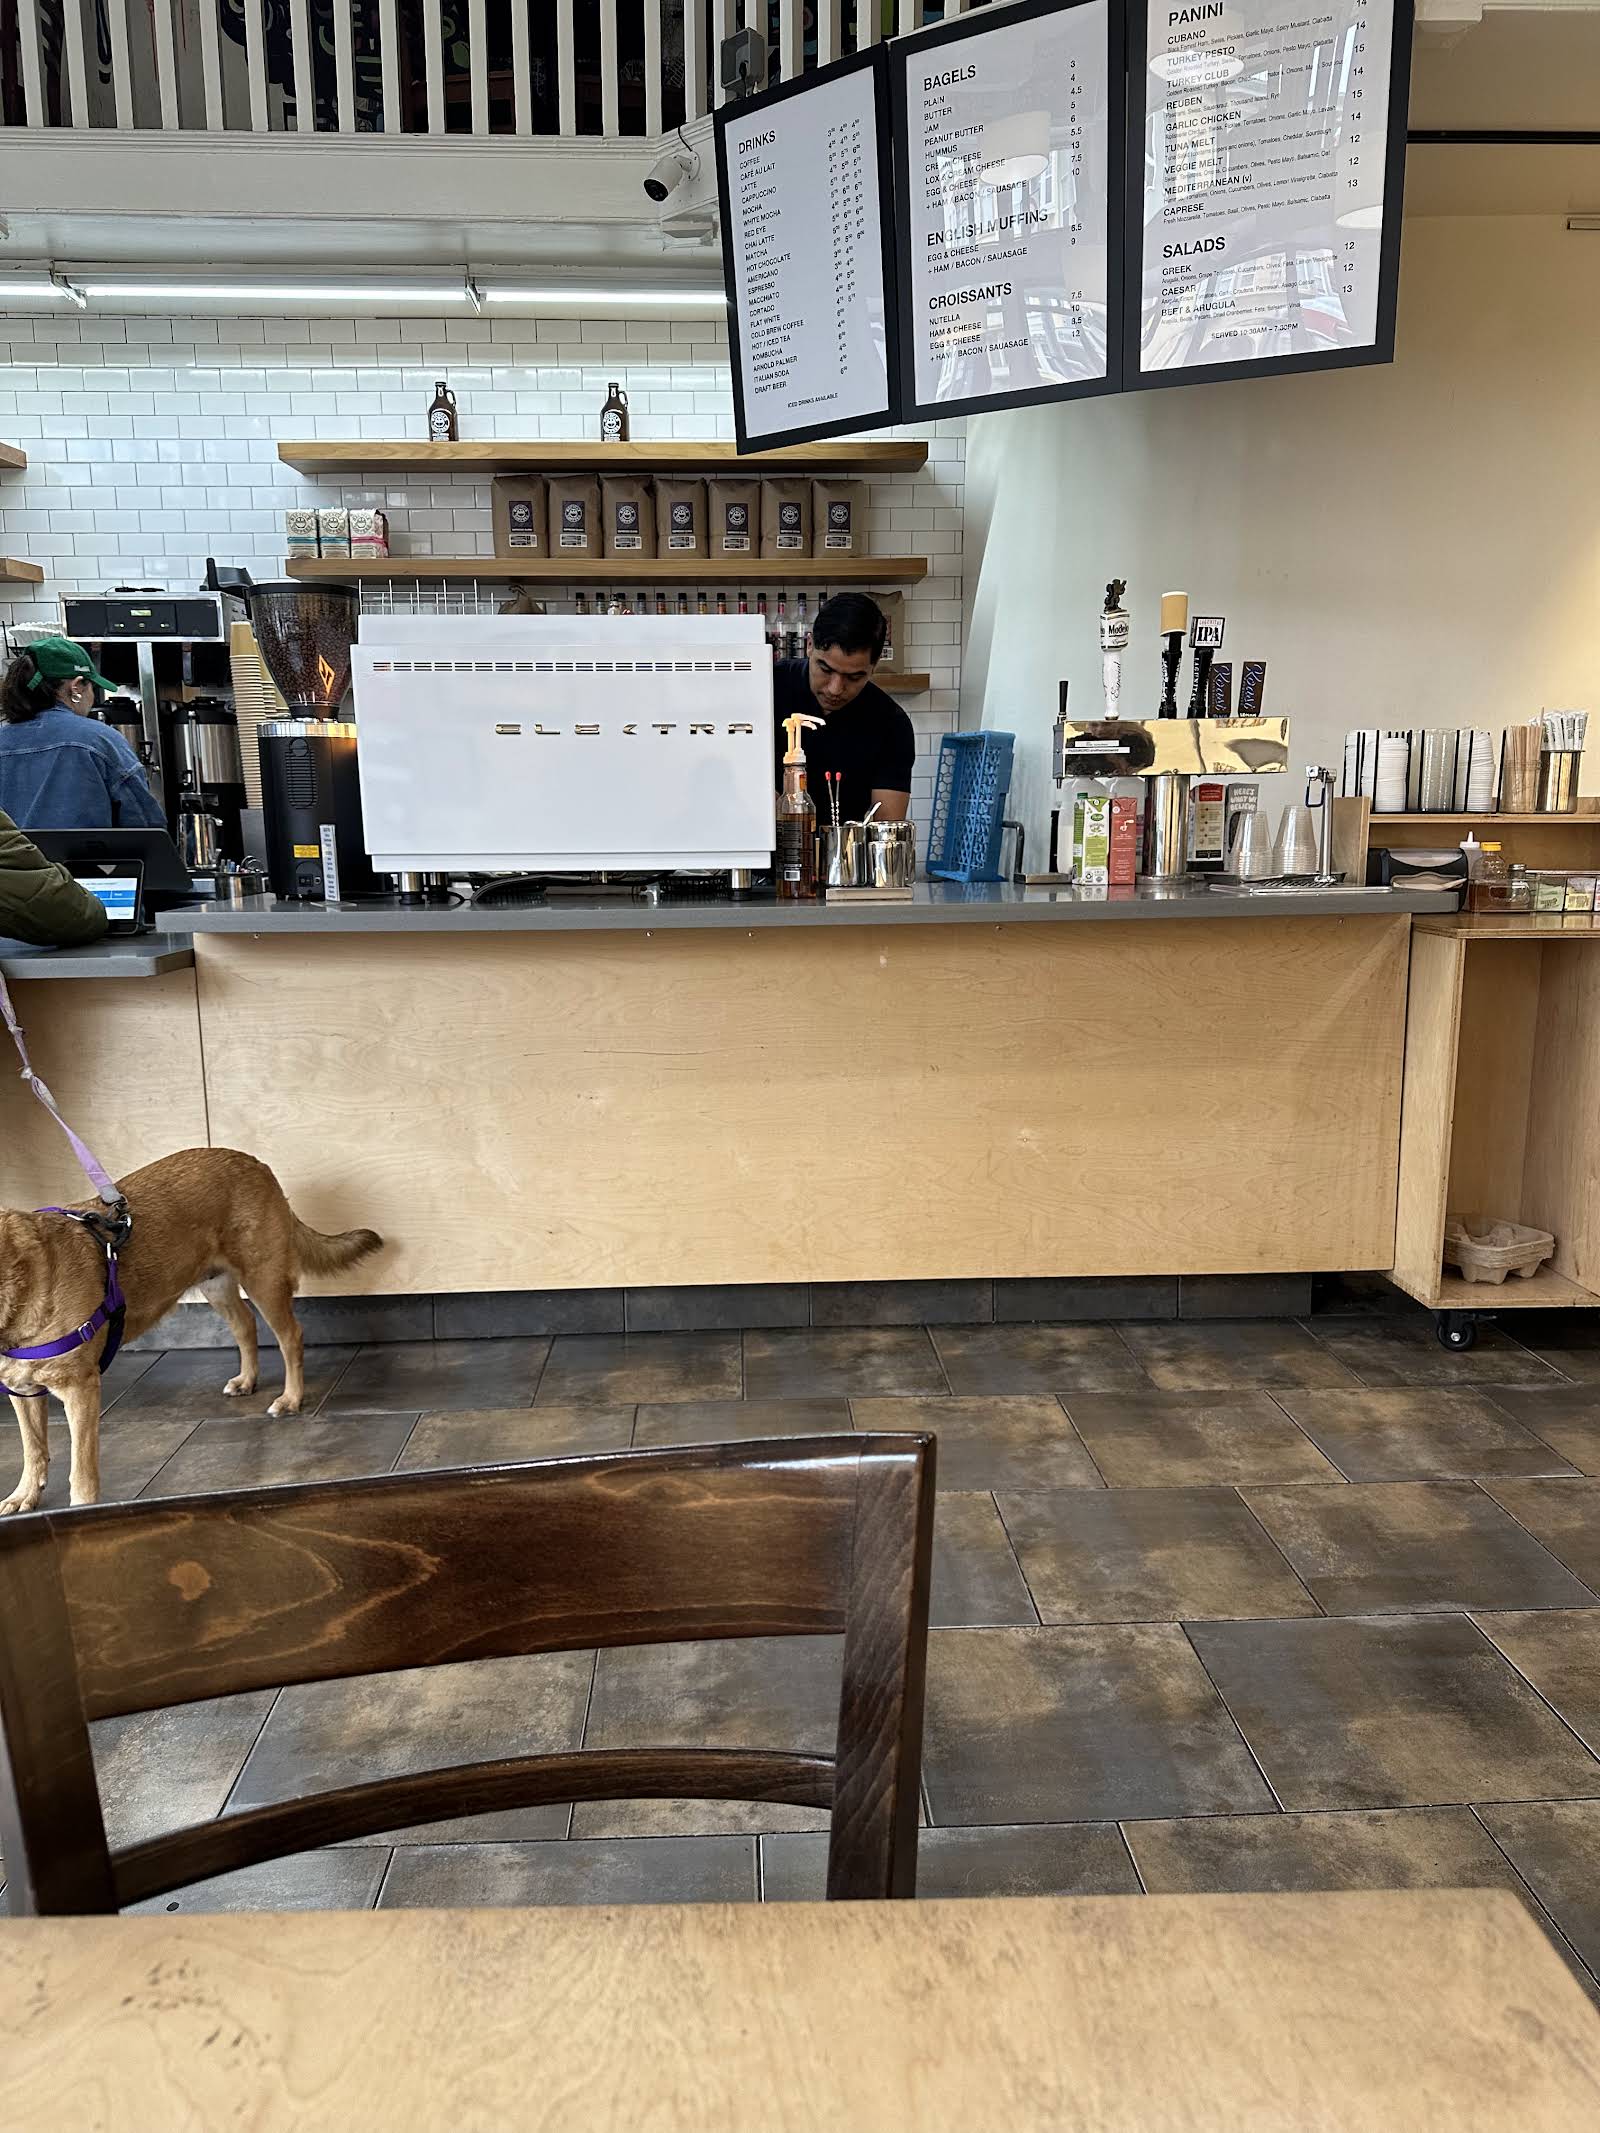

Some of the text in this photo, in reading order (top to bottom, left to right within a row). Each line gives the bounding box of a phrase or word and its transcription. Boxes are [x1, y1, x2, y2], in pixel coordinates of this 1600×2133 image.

[1169, 2, 1223, 26] PANINI
[1356, 21, 1366, 30] 14
[1168, 30, 1206, 44] CUBANO
[1355, 44, 1365, 52] 15
[1168, 46, 1234, 66] TURKEY PESTO
[1071, 60, 1076, 68] 3
[924, 64, 976, 92] BAGELS
[1071, 74, 1075, 82] 4
[1167, 69, 1229, 88] TURKEY CLUB
[1354, 67, 1363, 76] 14
[1071, 86, 1082, 96] 4.5
[1352, 90, 1362, 98] 15
[924, 96, 944, 108] PLAIN
[1071, 101, 1075, 109] 5
[1166, 96, 1202, 110] REUBEN
[924, 107, 952, 121] BUTTER
[1351, 112, 1361, 121] 14
[924, 123, 939, 134] JAM
[1166, 111, 1241, 132] GARLIC CHICKEN
[925, 124, 984, 146] PEANUT BUTTER
[1071, 127, 1082, 136] 5.5
[738, 131, 776, 154] DRINKS
[1071, 141, 1080, 150] 13
[1165, 137, 1215, 153] TUNA MELT
[1350, 135, 1360, 143] 12
[925, 144, 958, 159] HUMMUS
[1071, 154, 1082, 163] 7.5
[740, 156, 760, 169] COFFEE
[925, 151, 982, 172] CREM CHEESE
[1165, 157, 1223, 174] VEGGIE MELT
[1349, 157, 1359, 165] 12
[755, 167, 763, 176] AU
[764, 162, 776, 173] LAIT
[926, 175, 940, 185] LOX
[976, 158, 1006, 172] CHEESE
[1071, 168, 1080, 176] 10
[741, 181, 757, 192] LATTE
[926, 187, 941, 197] EGG
[949, 178, 978, 191] CHEESE
[1165, 176, 1240, 195] MEDITERRANEAN
[1348, 179, 1358, 187] 13
[742, 186, 776, 204] CAPPUCCINO
[743, 203, 762, 215] MOCHA
[1164, 203, 1204, 216] CAPRESE
[744, 209, 781, 227] WHITE MOCHA
[744, 226, 766, 238] RED EYE
[928, 208, 1048, 246] ENGLISH MUFFINS
[745, 234, 775, 250] CHAI LATTE
[1163, 236, 1226, 258] SALADS
[1345, 242, 1355, 250] 12
[746, 248, 767, 261] MATCHA
[928, 253, 942, 262] EGG
[950, 245, 979, 257] CHEESE
[934, 248, 1027, 273] HAM BACON SAUASAGE
[747, 253, 791, 272] HOT CHOCOLATE
[747, 268, 778, 283] AMERICANO
[1162, 265, 1192, 276] GREEK
[748, 281, 775, 294] ESPRESSO
[1162, 284, 1196, 296] CAESAR
[749, 292, 780, 306] MACCHIATO
[929, 283, 1012, 310] CROISSANTS
[1071, 291, 1082, 299] 7.5
[750, 304, 775, 317] CORTADO
[1194, 300, 1236, 312] ARUGULA
[751, 314, 780, 328] FLAT WHITE
[929, 314, 960, 325] NUTELLA
[751, 319, 804, 339] COLD BREW COFFEE
[930, 329, 945, 337] HAM
[953, 322, 981, 333] CHEESE
[1212, 330, 1238, 340] SERVED
[752, 335, 790, 350] HOT ICED TEA
[930, 341, 944, 349] EGG
[953, 335, 980, 345] CHEESE
[958, 347, 982, 357] BACON
[989, 339, 1028, 351] SAUASAGE
[753, 348, 782, 361] KOMBUCHA
[753, 355, 798, 372] ARNOLD PALMER
[754, 369, 789, 383] ITALIAN SODA
[755, 381, 786, 394] DRAFT BEER
[1197, 627, 1219, 641] IPA
